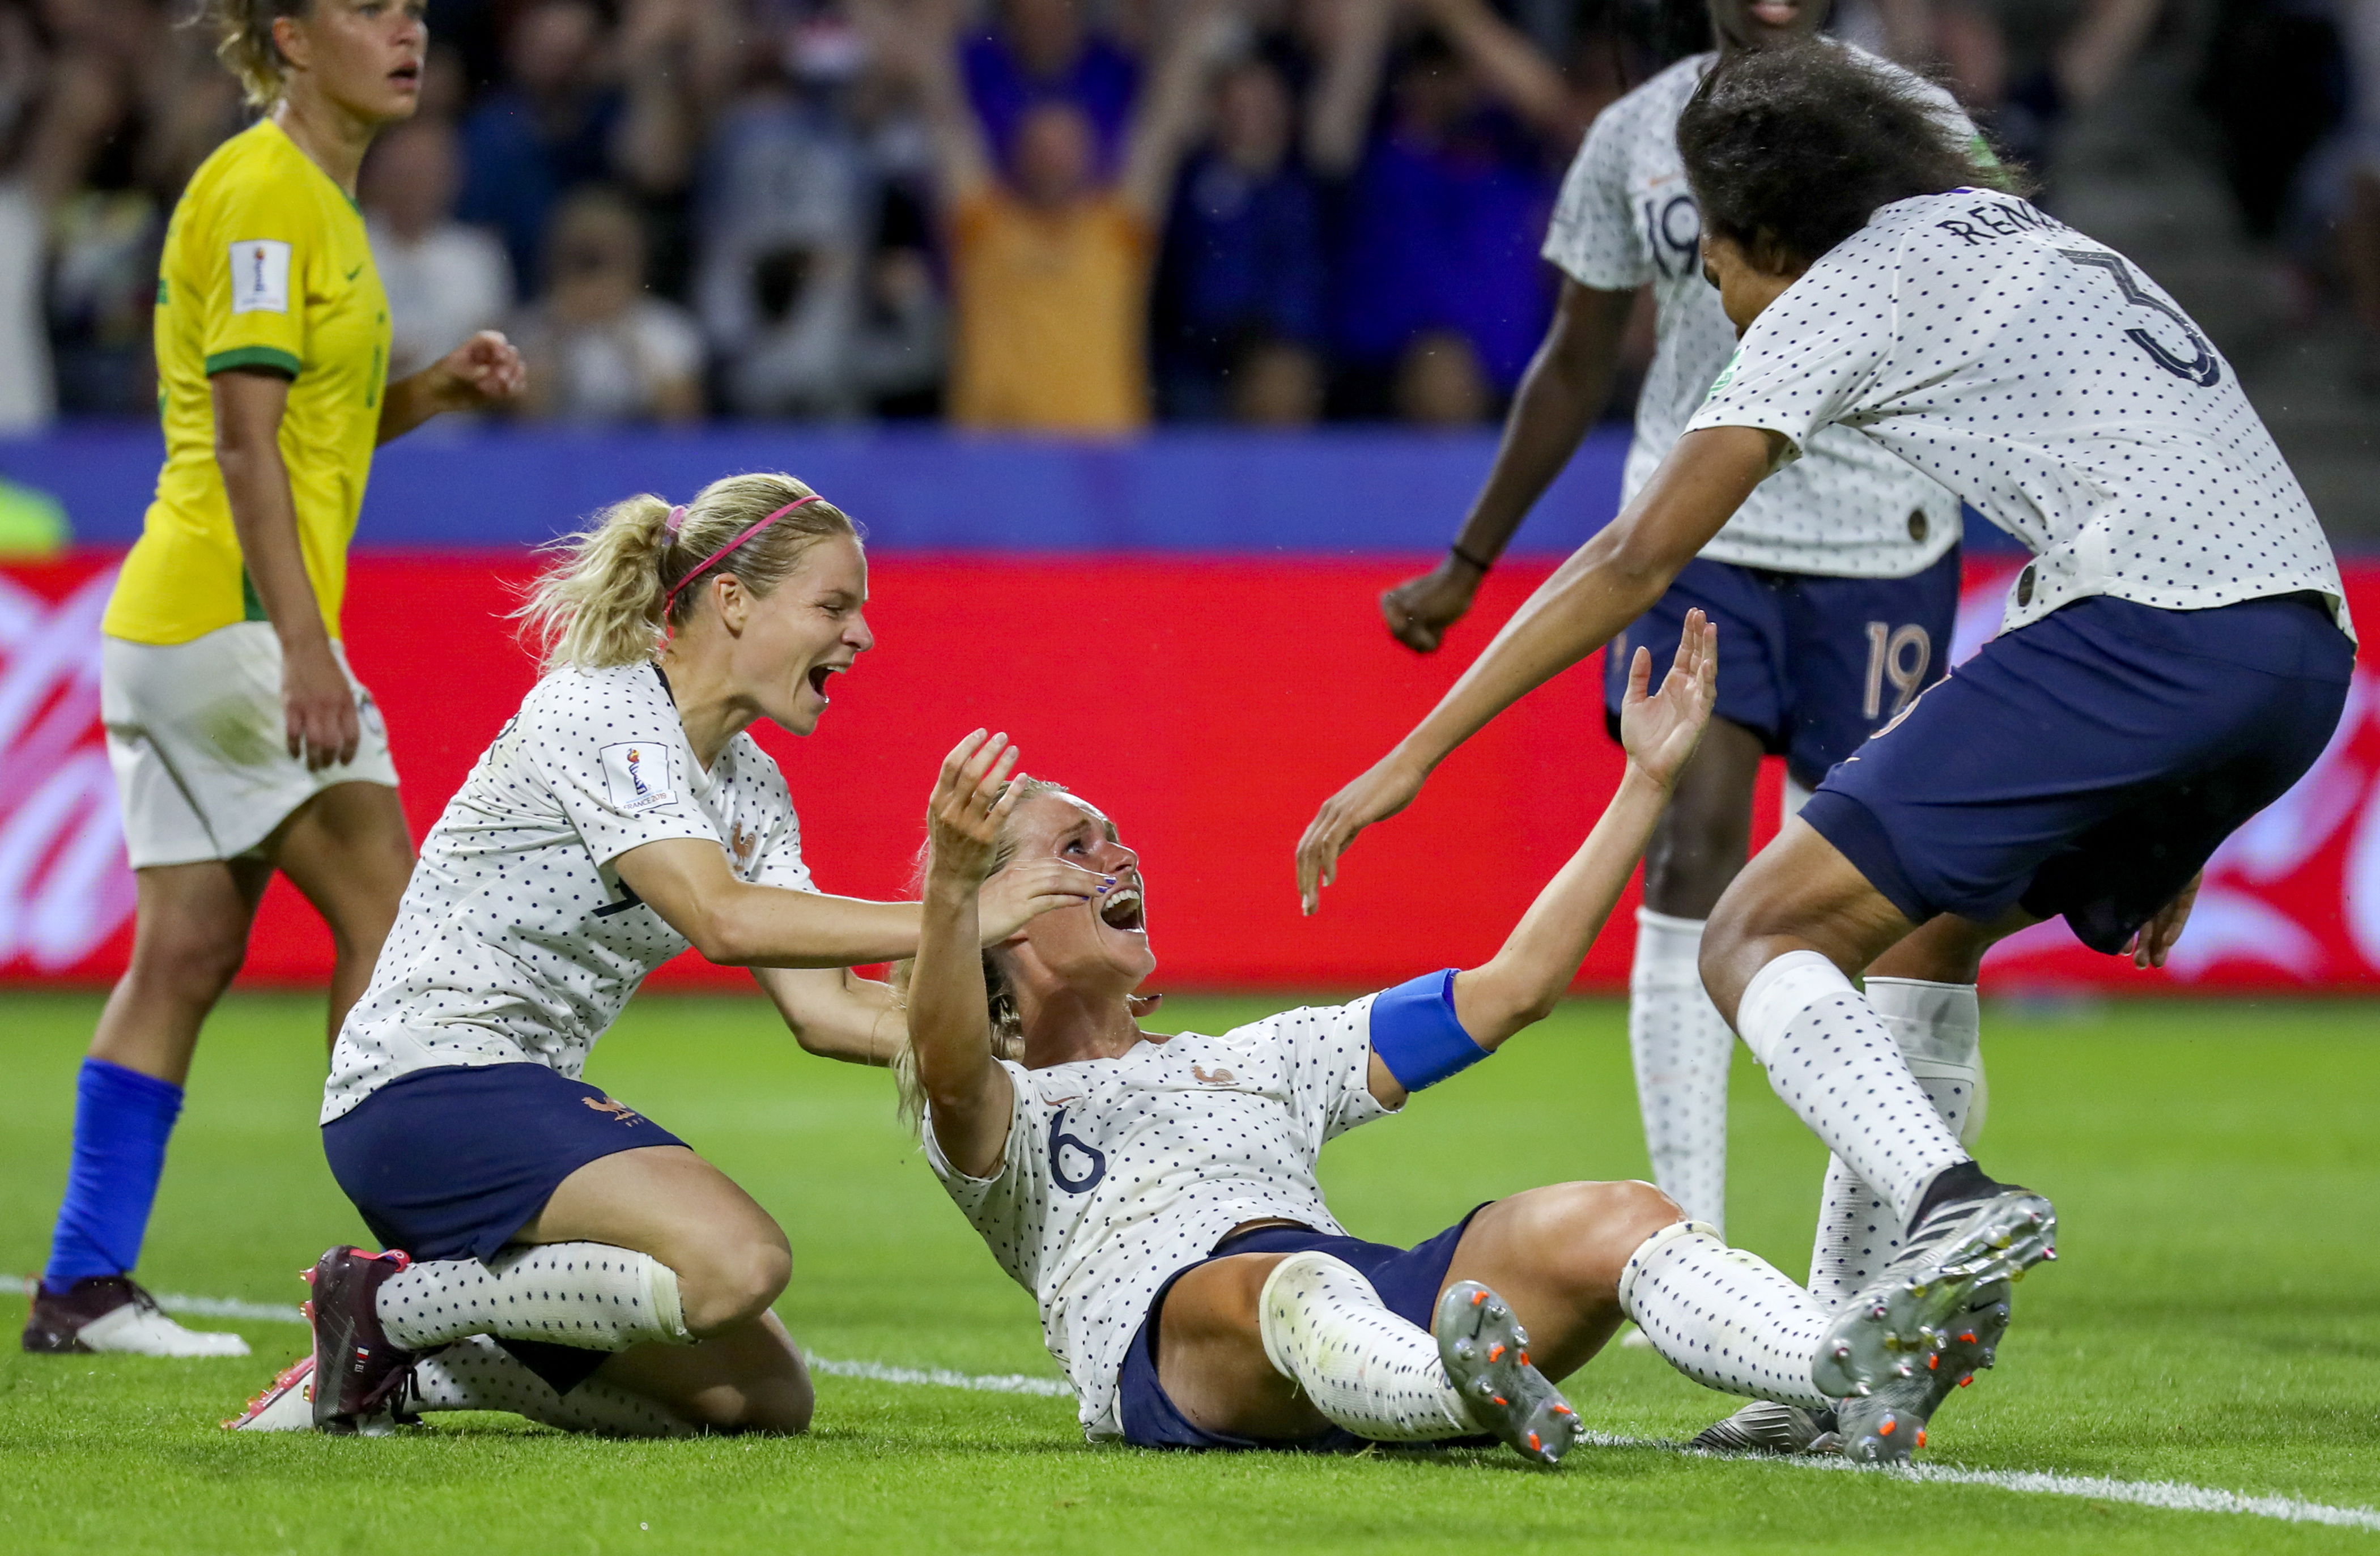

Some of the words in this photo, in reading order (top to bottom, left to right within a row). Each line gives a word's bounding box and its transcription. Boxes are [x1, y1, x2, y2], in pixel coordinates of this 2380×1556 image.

[1645, 196, 1701, 280] 19
[2056, 248, 2221, 388] 3
[1863, 621, 1931, 720] 19
[623, 797, 652, 810] FRANCE
[651, 792, 667, 802] 2019
[1048, 1107, 1107, 1194] 6
